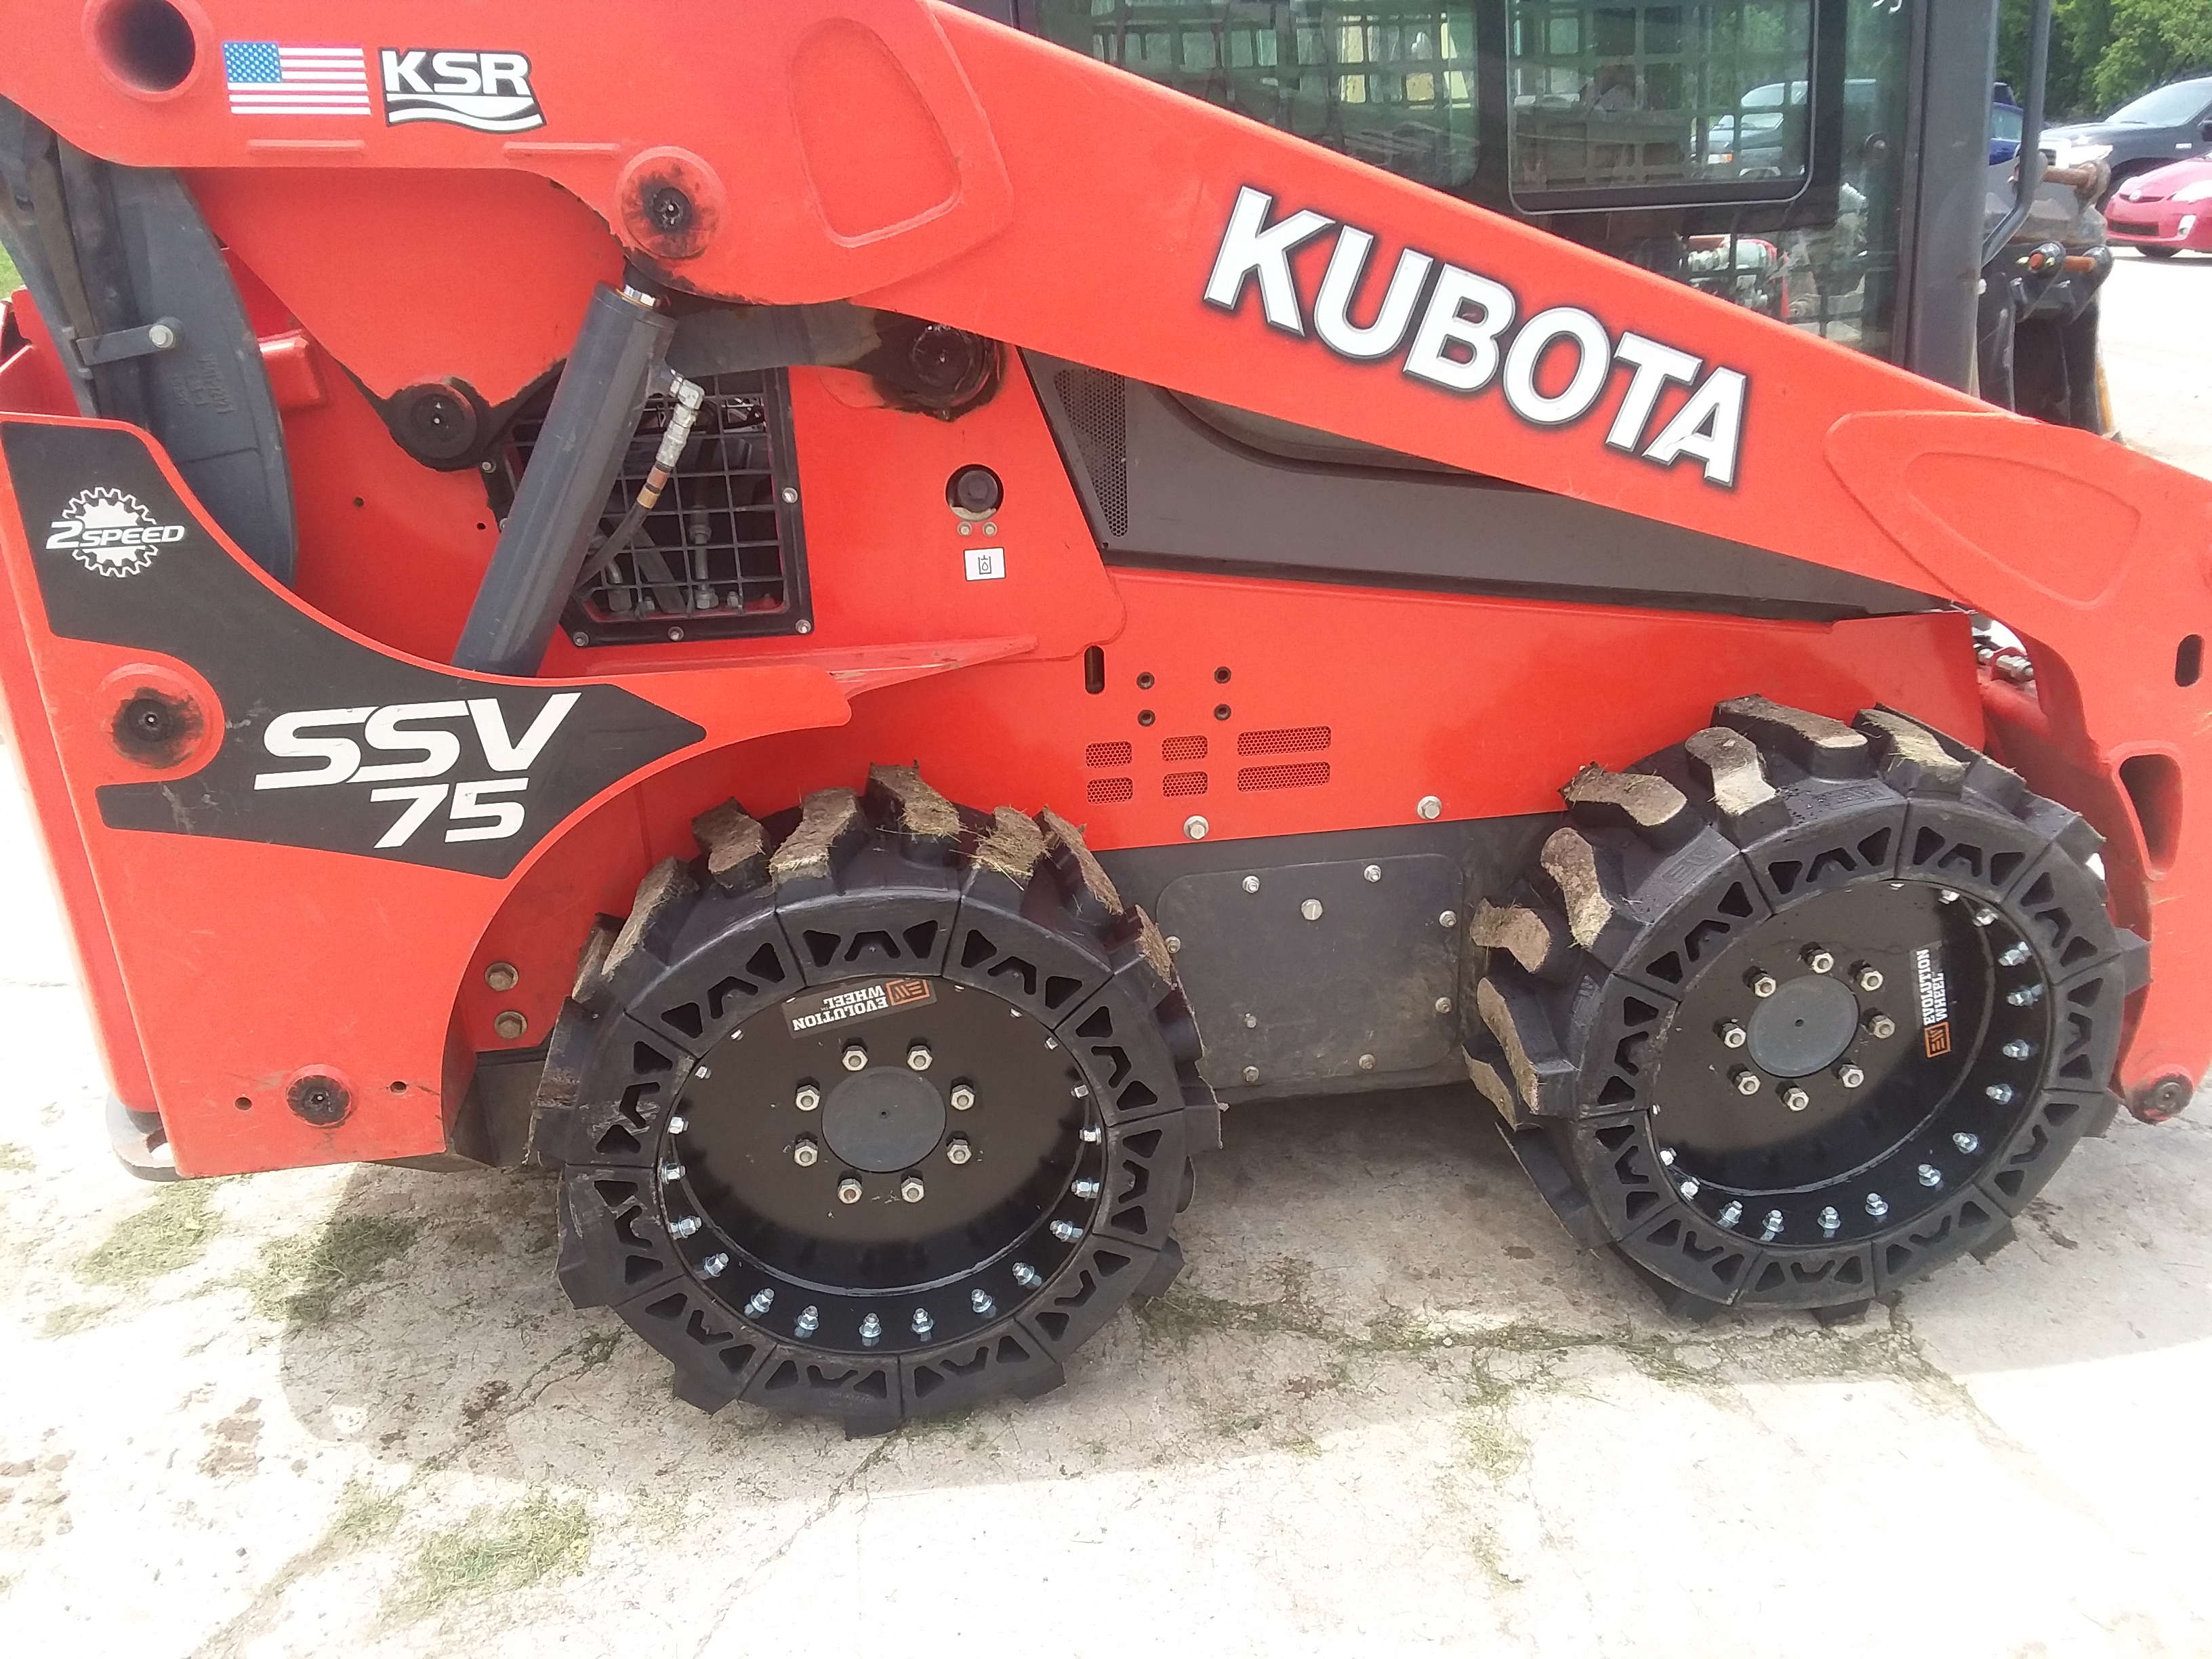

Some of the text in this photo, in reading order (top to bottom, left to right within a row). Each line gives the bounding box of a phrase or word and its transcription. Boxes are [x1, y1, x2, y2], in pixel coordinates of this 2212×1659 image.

[382, 49, 531, 96] KSR
[1204, 185, 1748, 489] KUBOTA
[254, 692, 582, 791] SSV
[369, 777, 530, 849] 75
[792, 996, 889, 1031] EVOLUTION
[823, 985, 886, 1010] WHEEL
[1916, 949, 1936, 1026] EVOLUTION
[1932, 972, 1948, 1022] WHEEL
